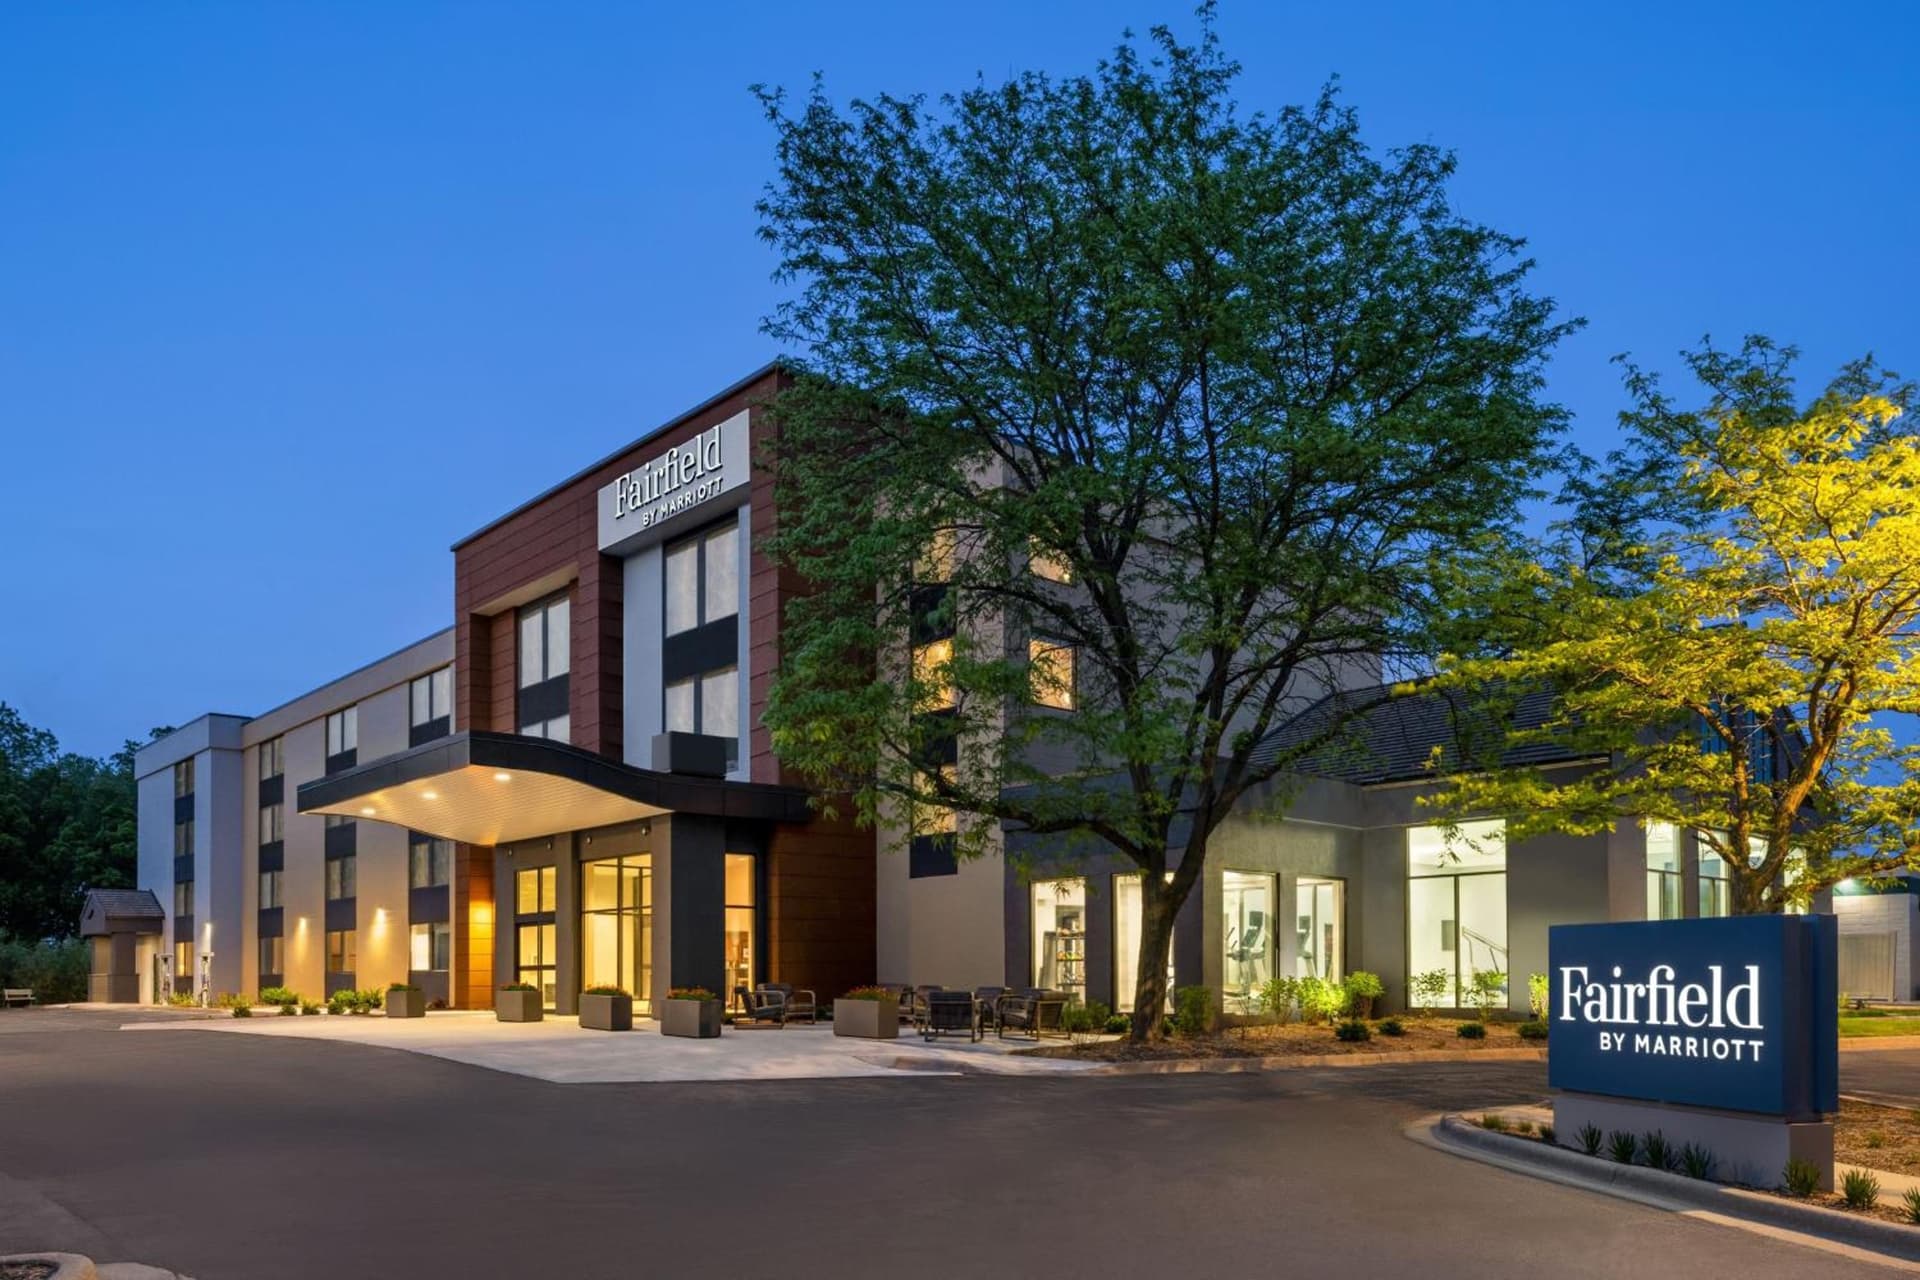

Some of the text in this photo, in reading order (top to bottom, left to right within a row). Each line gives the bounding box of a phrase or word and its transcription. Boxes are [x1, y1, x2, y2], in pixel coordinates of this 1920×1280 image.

[614, 425, 723, 519] Fairfield
[642, 476, 723, 526] BY MARRIOTT
[1559, 964, 1764, 1029] Fairfield
[1600, 1032, 1764, 1062] BY MARRIOTT
